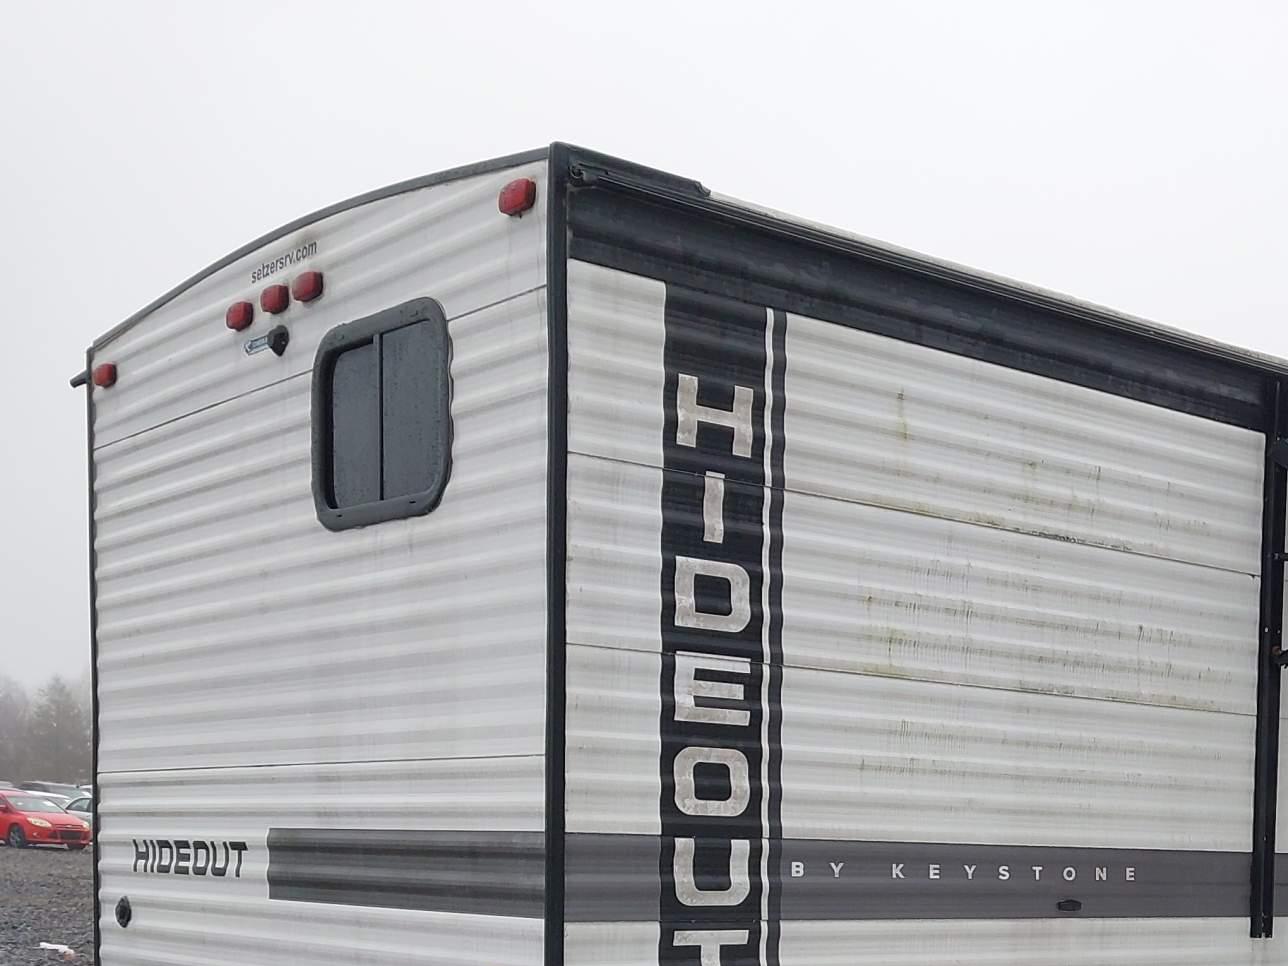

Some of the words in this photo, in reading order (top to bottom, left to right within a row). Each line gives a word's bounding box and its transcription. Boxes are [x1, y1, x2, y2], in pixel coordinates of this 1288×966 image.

[251, 240, 318, 284] setzersrv.com
[132, 838, 248, 878] HIDEOUT
[790, 861, 845, 879] BY
[891, 863, 1137, 882] KEYSTONE
